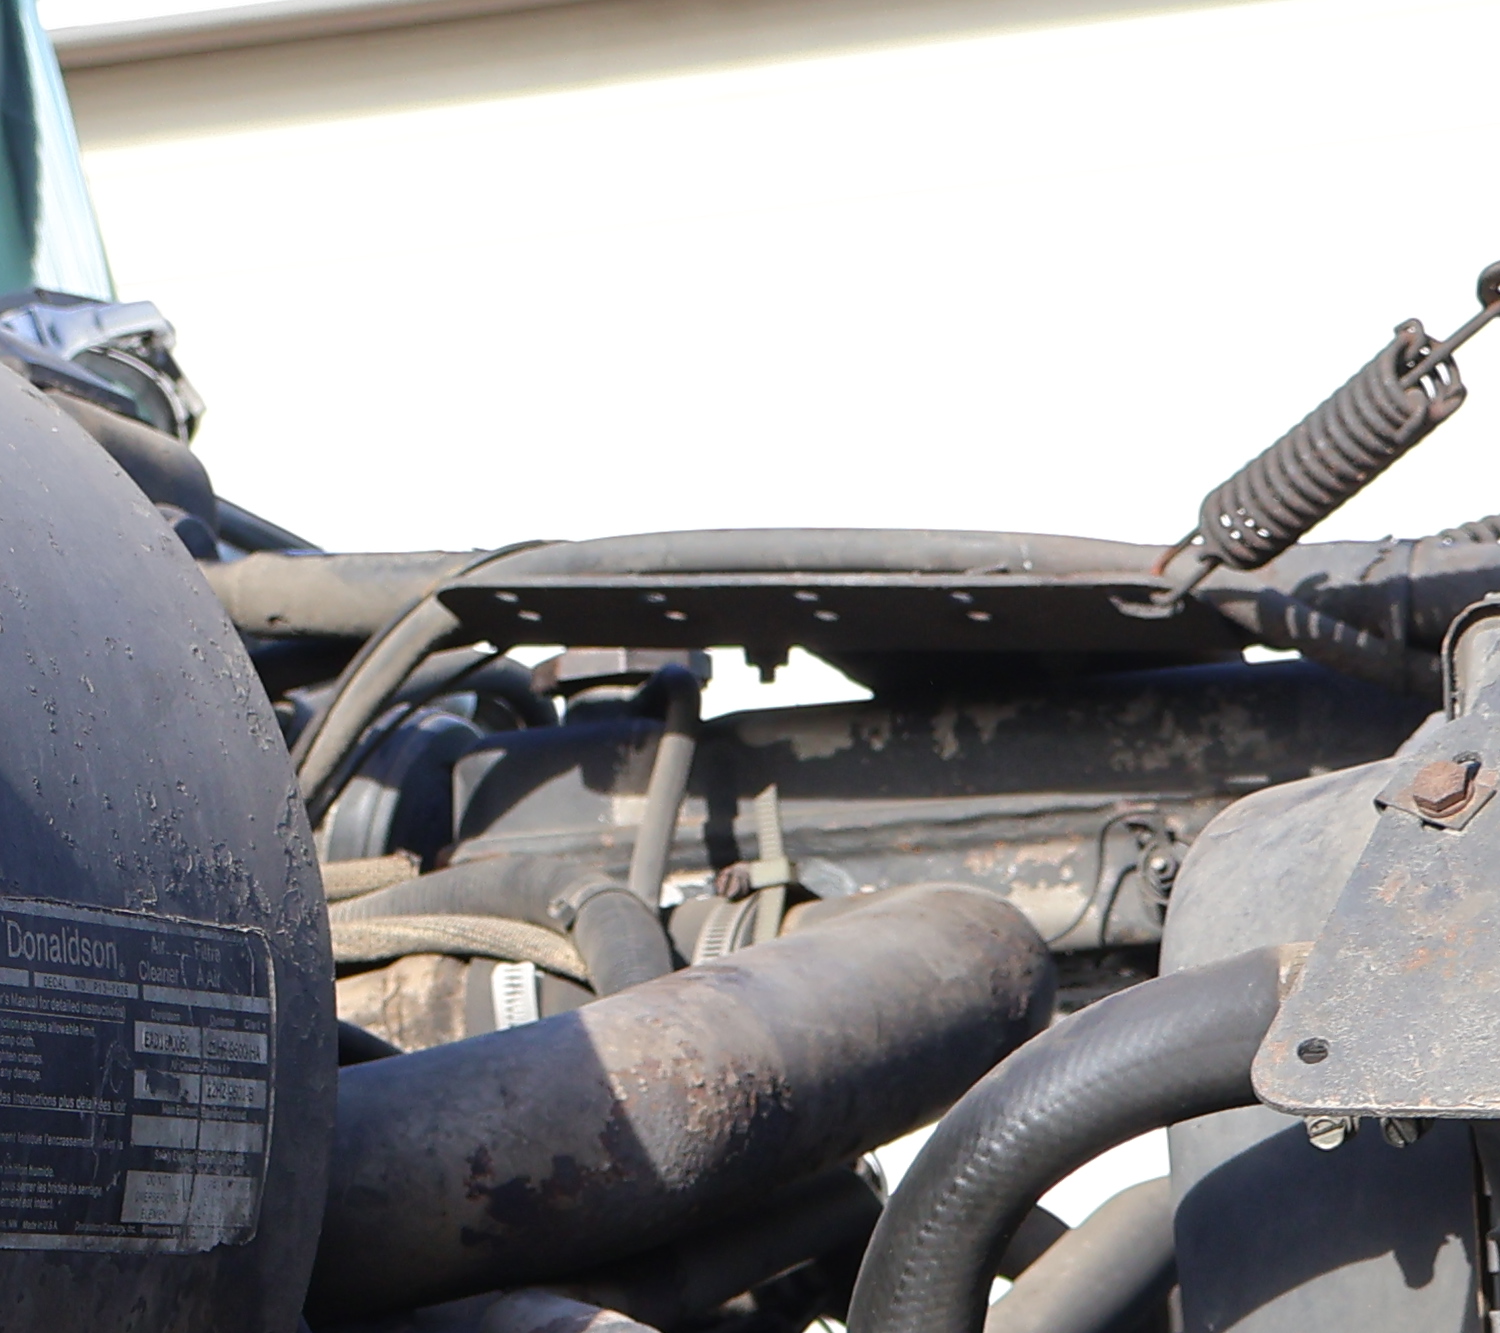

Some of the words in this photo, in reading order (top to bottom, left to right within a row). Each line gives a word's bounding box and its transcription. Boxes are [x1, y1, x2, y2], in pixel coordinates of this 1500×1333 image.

[5, 918, 119, 970] Donaldson
[138, 959, 180, 985] Cleaner
[11, 993, 38, 1009] Manual
[39, 995, 50, 1010] for
[51, 998, 81, 1014] detailed
